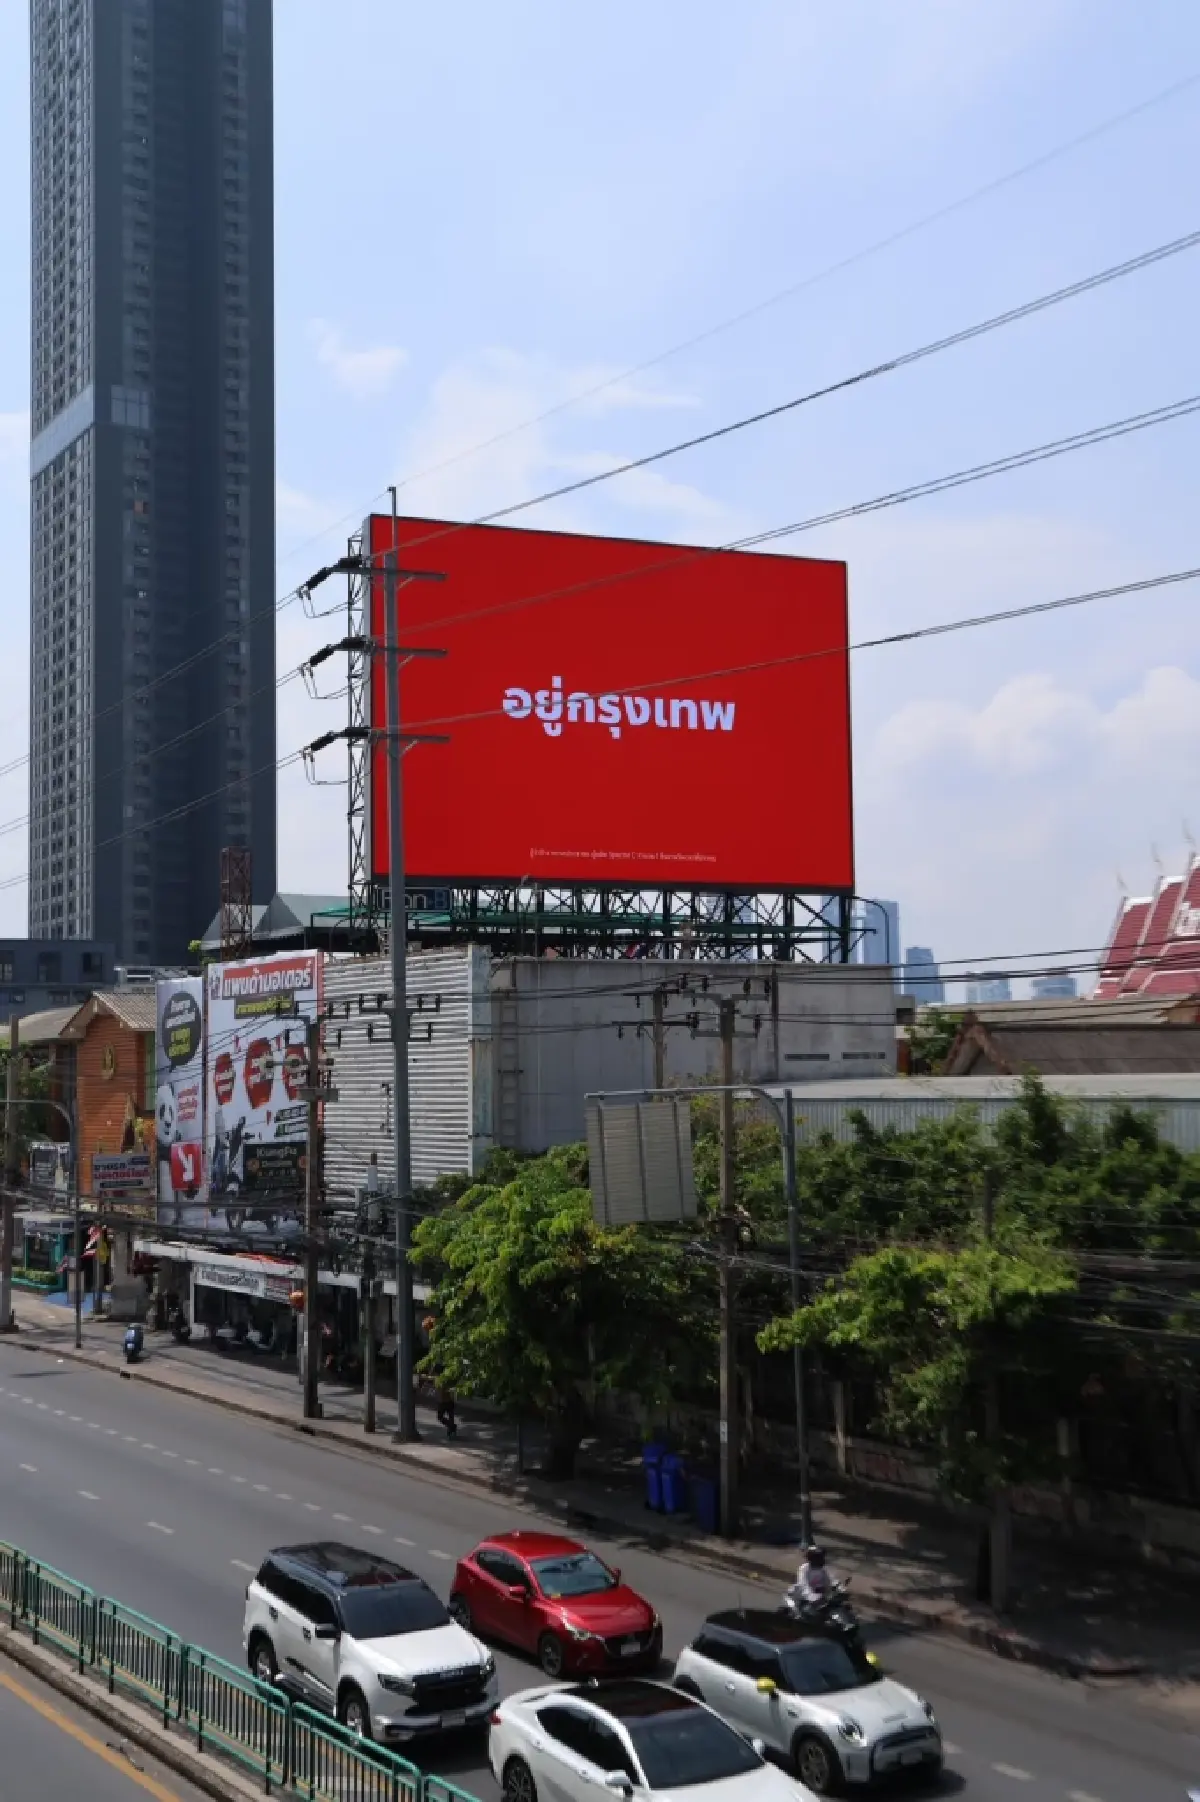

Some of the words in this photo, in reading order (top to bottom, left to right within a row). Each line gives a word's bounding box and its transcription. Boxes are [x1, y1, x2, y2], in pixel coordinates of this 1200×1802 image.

[503, 675, 736, 739] อยู่กรุงเทพ
[381, 889, 427, 909] Pan
